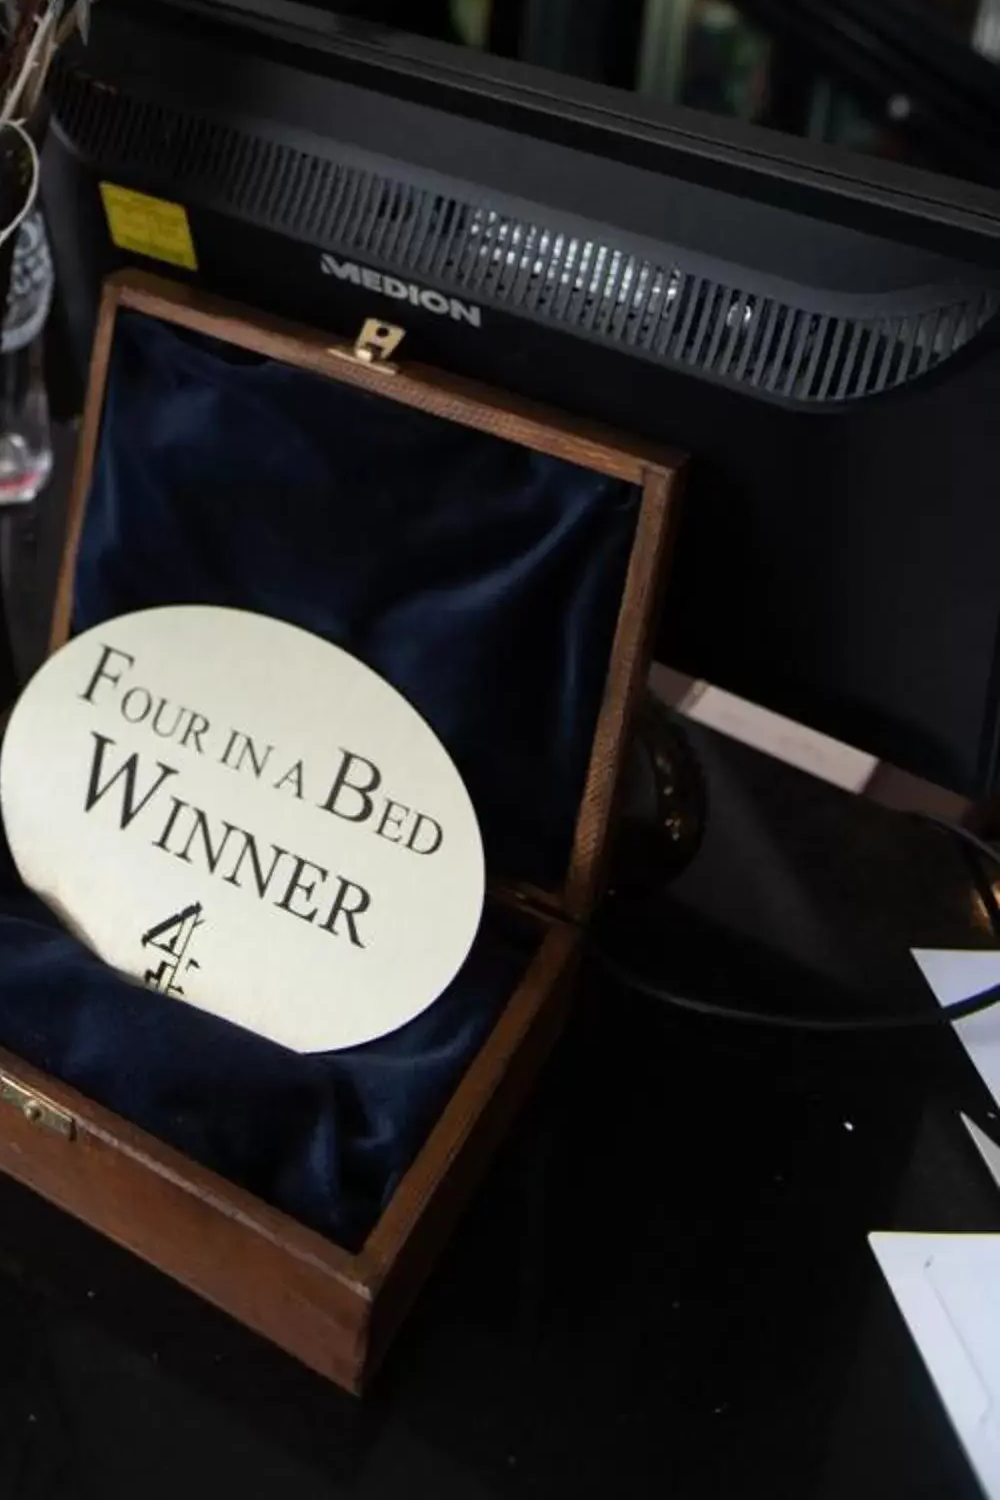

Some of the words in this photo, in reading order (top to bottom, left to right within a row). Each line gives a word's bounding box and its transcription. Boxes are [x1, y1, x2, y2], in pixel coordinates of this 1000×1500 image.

[320, 252, 481, 328] MEDION
[79, 644, 210, 754] FOUR
[219, 730, 275, 778] IN
[274, 760, 305, 800] A
[318, 747, 444, 856] BED
[83, 731, 370, 949] WINNER
